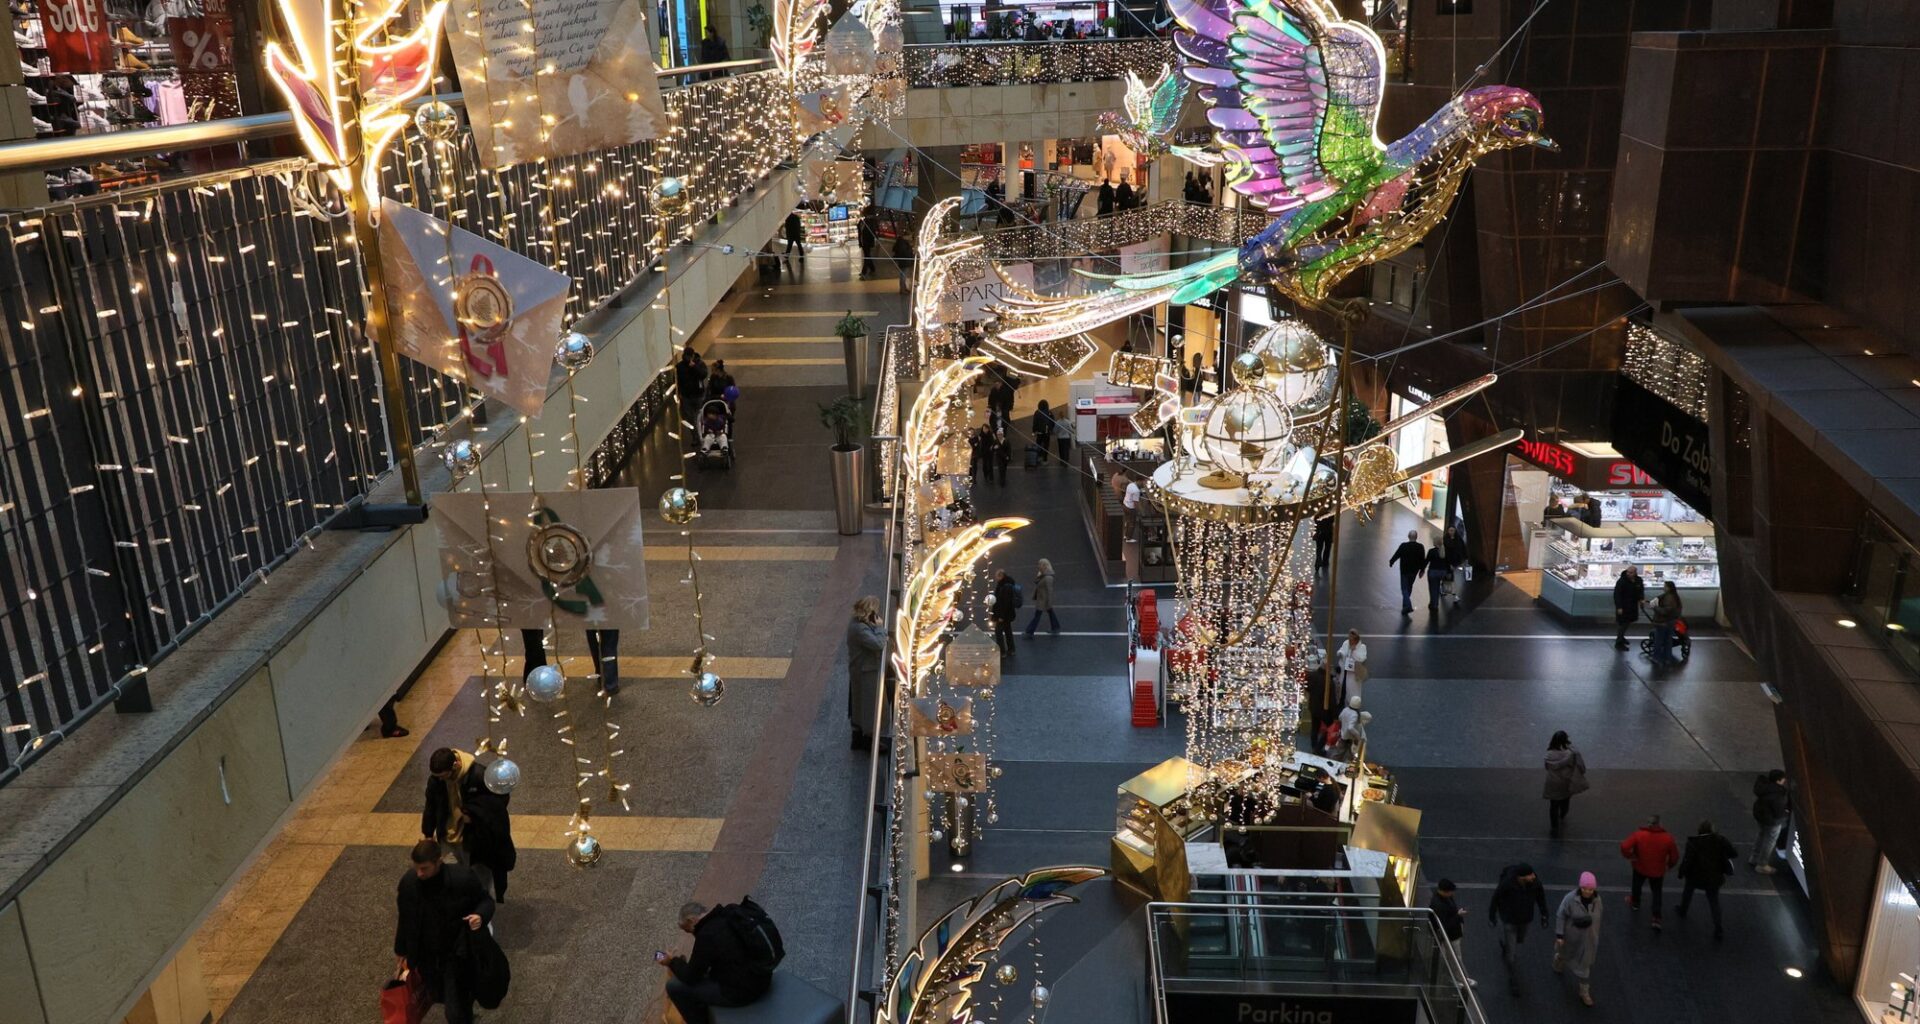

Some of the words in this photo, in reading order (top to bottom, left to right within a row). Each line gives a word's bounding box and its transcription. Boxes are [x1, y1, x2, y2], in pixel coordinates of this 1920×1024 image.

[49, 0, 98, 33] Sale
[1661, 420, 1680, 455] Do
[1238, 1001, 1333, 1024] Parking
